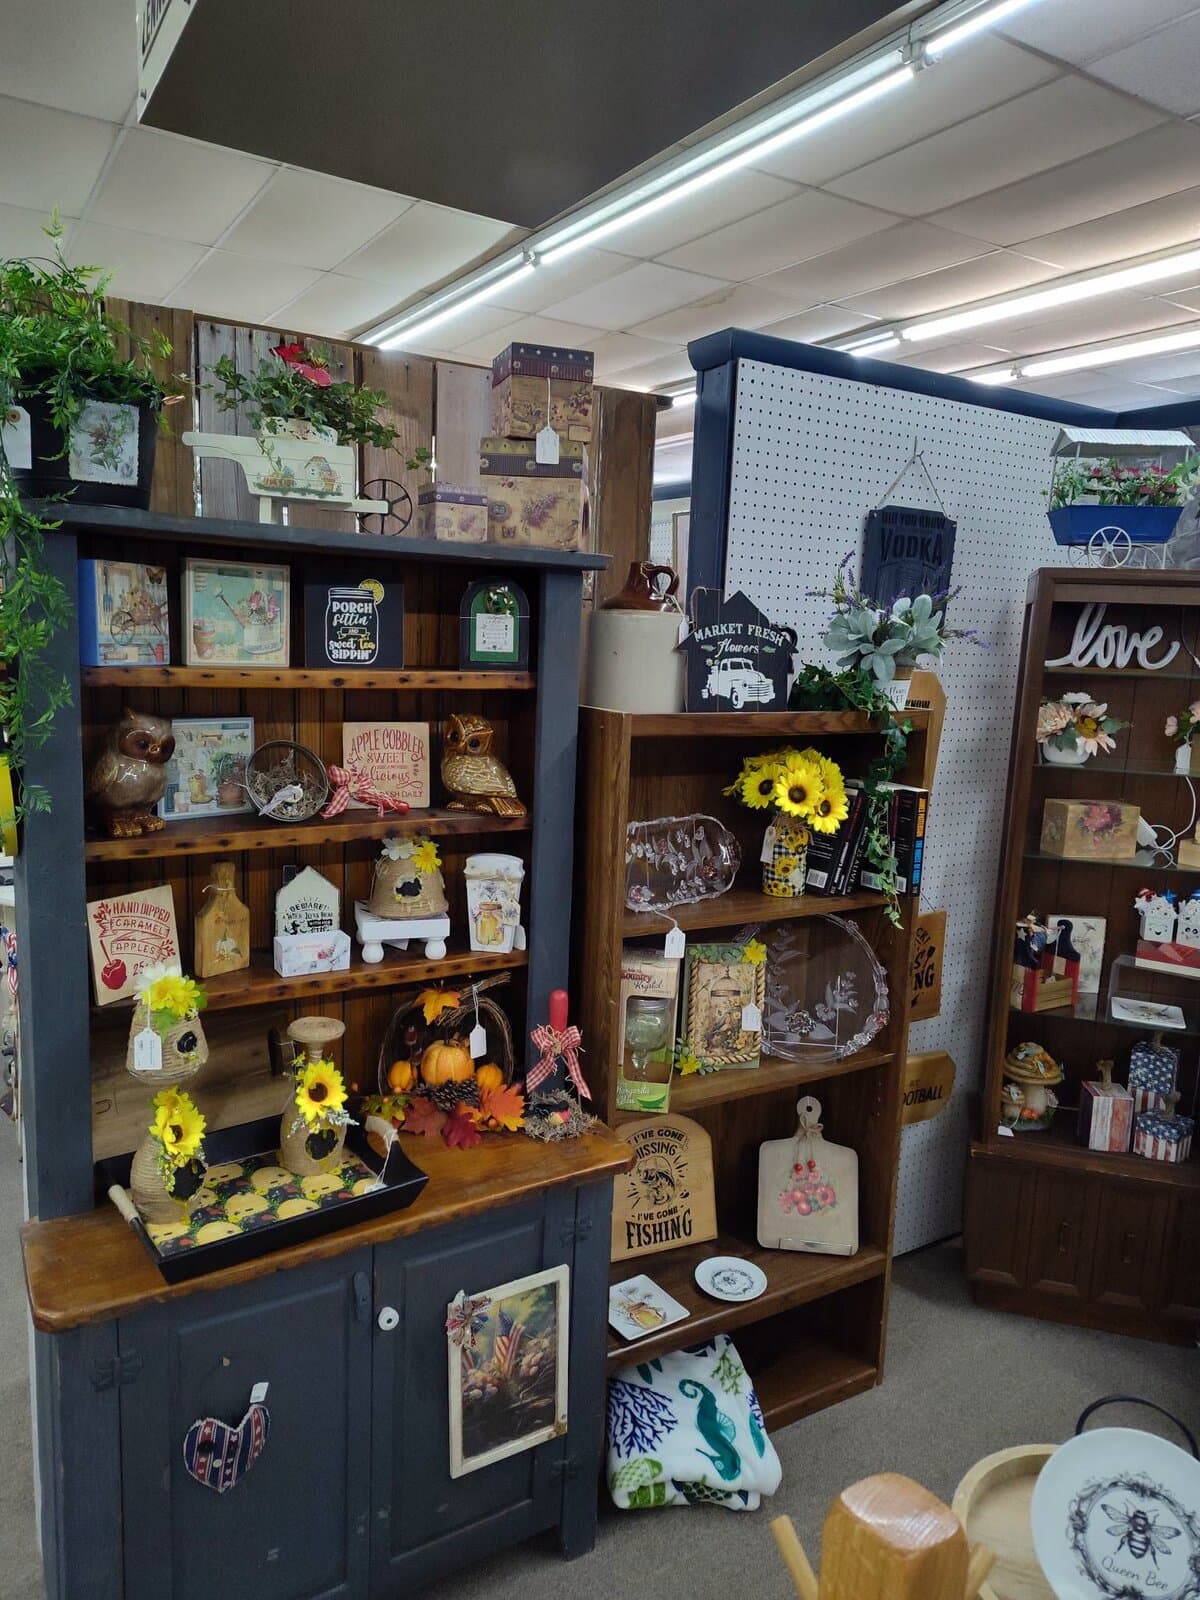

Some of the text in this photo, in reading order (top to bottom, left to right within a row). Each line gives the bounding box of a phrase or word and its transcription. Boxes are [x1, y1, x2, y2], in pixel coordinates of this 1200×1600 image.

[881, 528, 943, 567] VODKA
[332, 601, 372, 613] PORCH
[693, 623, 784, 647] MARKET FRESH
[1044, 602, 1180, 670] love
[714, 638, 759, 658] flowers
[350, 728, 425, 762] APPLE COBBLER
[367, 752, 406, 763] SWEET
[113, 901, 139, 915] HAND
[115, 918, 164, 935] CARAMEL
[116, 942, 156, 955] APPLES
[903, 1085, 942, 1106] OTBALL
[634, 1129, 685, 1143] I'VE GONE
[638, 1206, 679, 1221] I'VE GONE
[625, 1208, 693, 1250] FISHING
[1101, 1556, 1140, 1581] Queen
[1145, 1571, 1169, 1590] Bee
